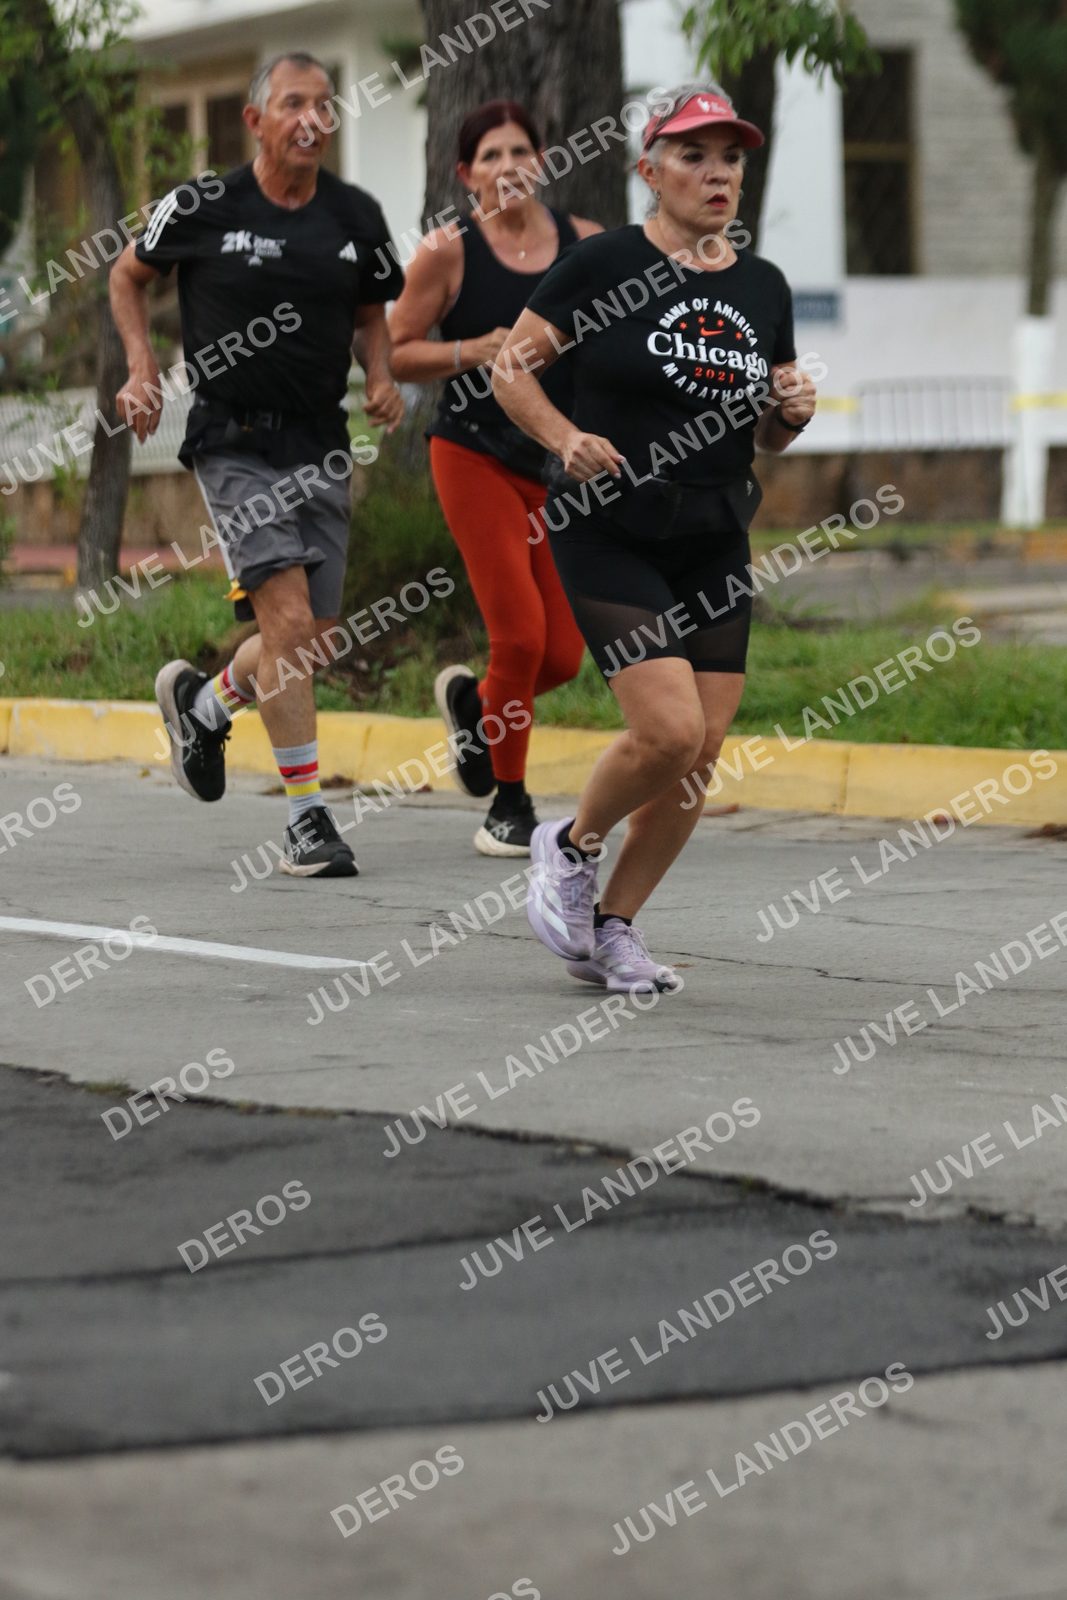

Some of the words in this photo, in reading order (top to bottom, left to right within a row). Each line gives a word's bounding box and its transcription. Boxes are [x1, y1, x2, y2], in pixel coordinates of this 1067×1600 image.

[658, 301, 691, 330] BANK
[691, 297, 709, 312] OF
[713, 300, 758, 348] AMERICA
[646, 330, 769, 381] Chicago
[694, 366, 735, 384] 2021
[661, 362, 757, 402] MARATHON
